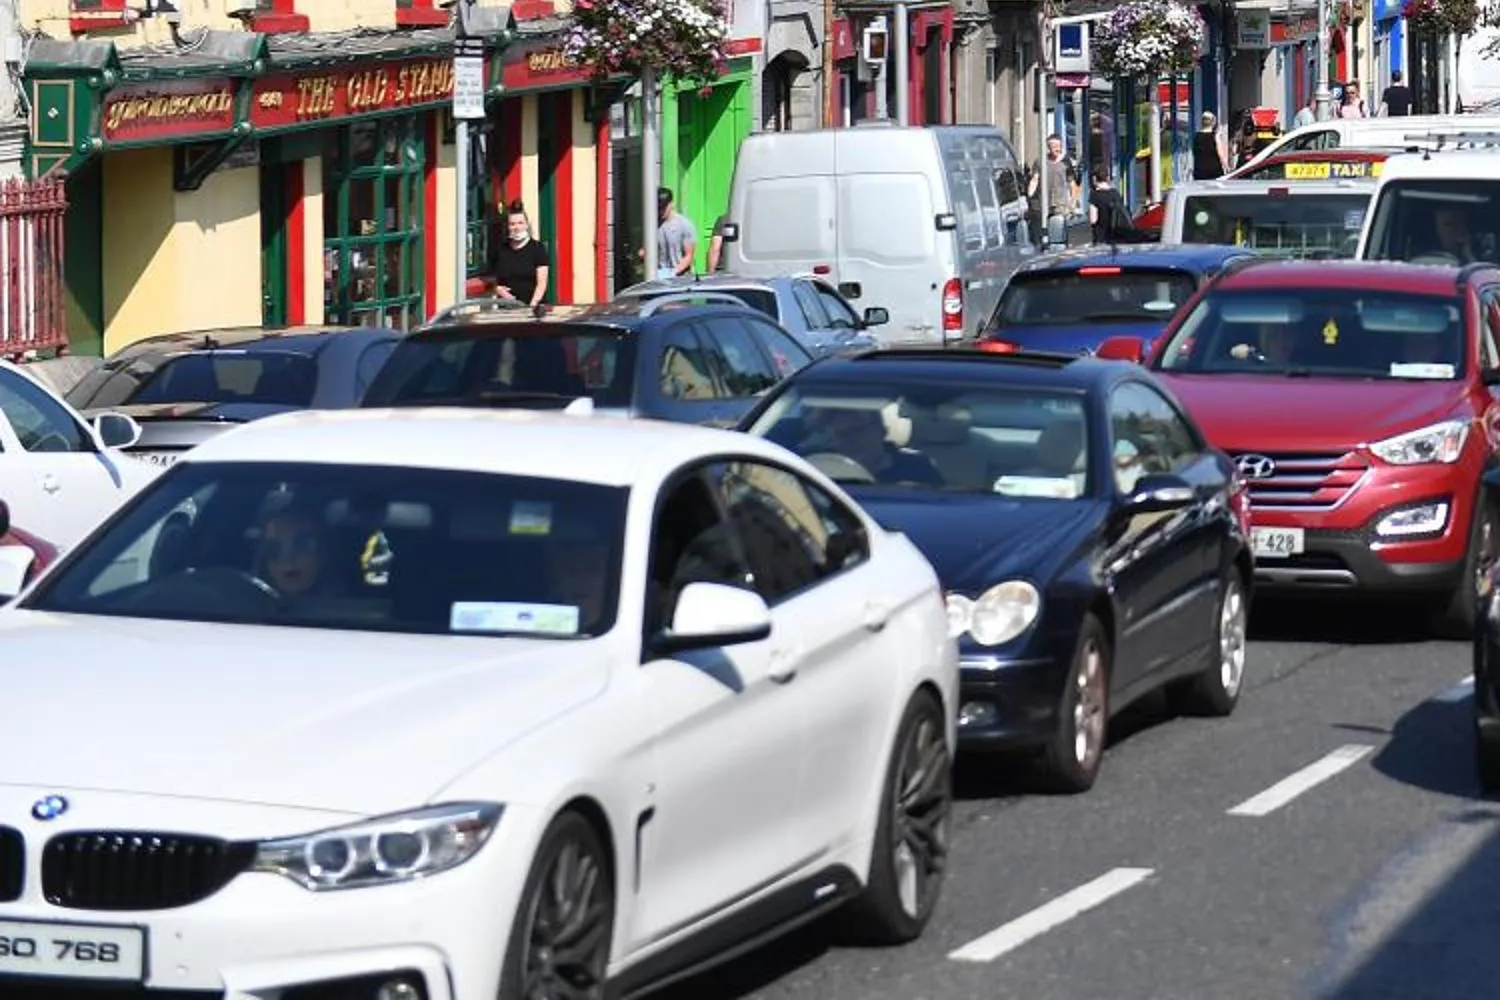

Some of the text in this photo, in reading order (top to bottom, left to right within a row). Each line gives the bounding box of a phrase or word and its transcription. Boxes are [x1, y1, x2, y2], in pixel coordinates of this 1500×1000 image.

[297, 76, 335, 115] THE
[347, 69, 388, 108] OLD
[1331, 163, 1366, 178] TAXI
[52, 940, 120, 963] 768
